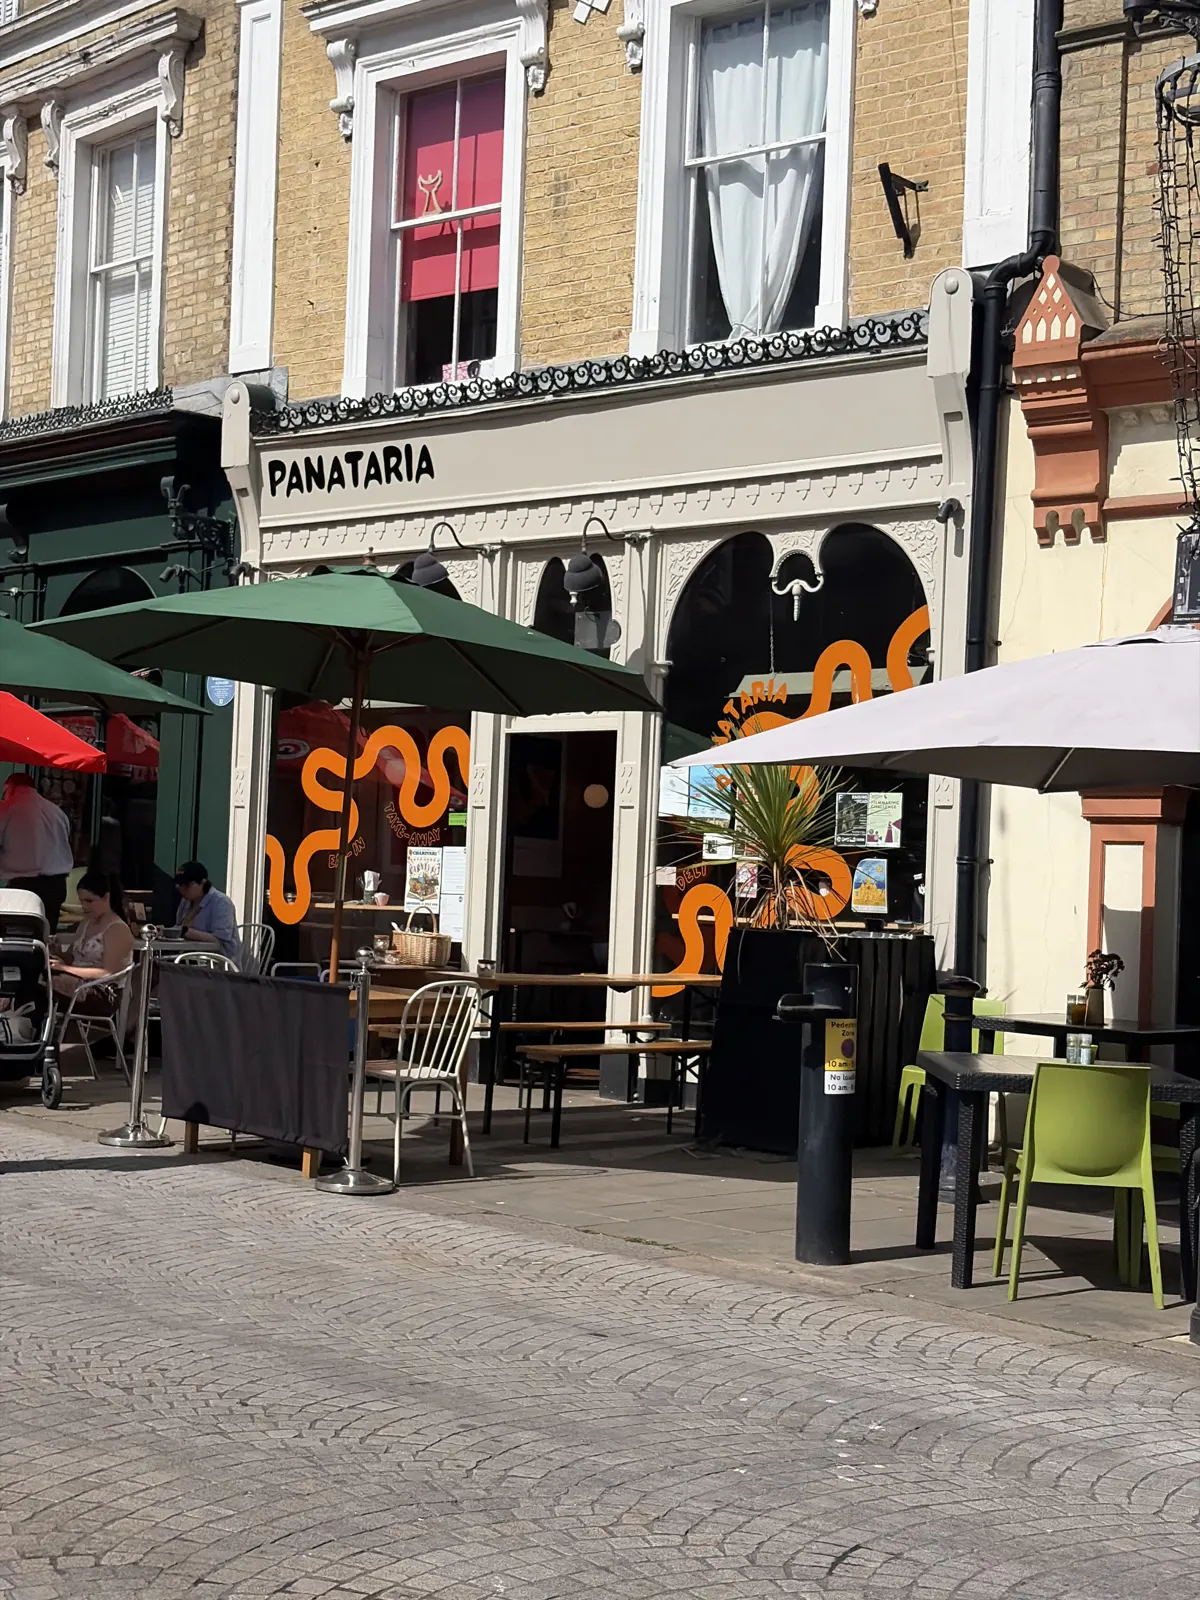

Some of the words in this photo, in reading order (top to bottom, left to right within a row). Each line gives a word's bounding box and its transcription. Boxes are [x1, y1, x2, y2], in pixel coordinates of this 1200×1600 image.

[268, 443, 435, 498] PANATARIA
[384, 801, 441, 846] TAKE-AWAY
[328, 837, 366, 869] E-IN
[675, 865, 707, 891] DELI
